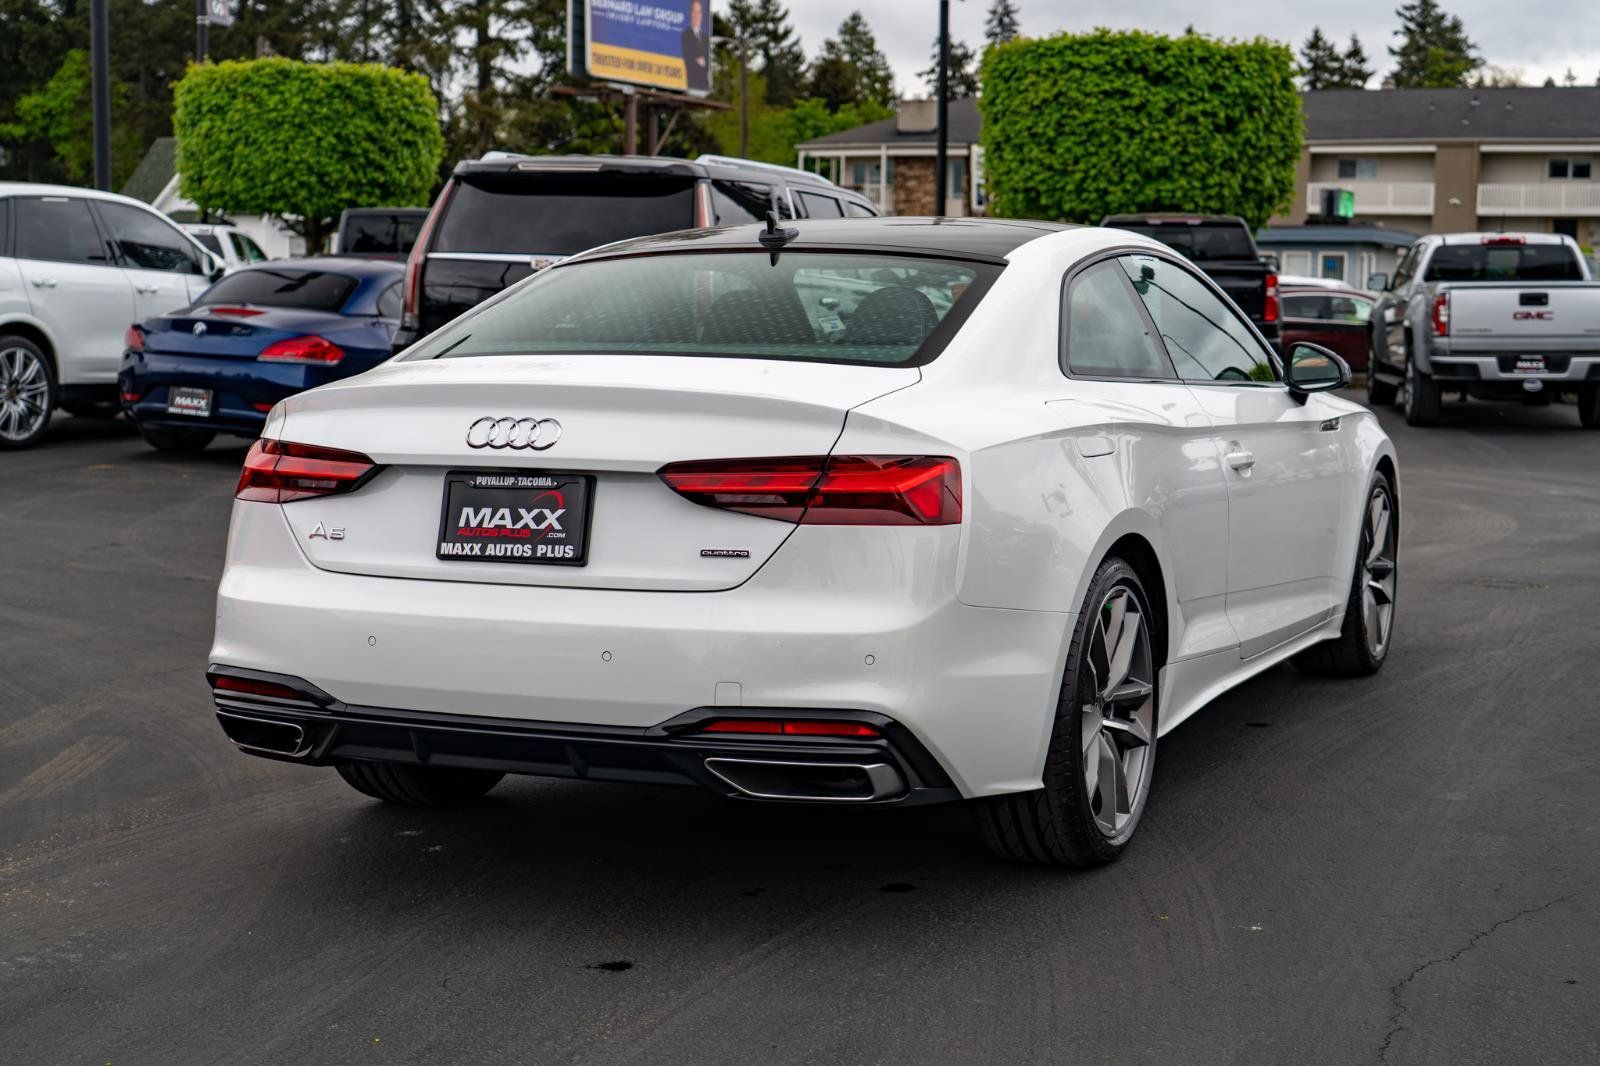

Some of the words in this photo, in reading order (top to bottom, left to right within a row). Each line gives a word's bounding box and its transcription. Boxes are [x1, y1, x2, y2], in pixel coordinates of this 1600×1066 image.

[634, 3, 654, 16] LAW
[654, 8, 684, 24] GROUP
[1513, 311, 1553, 321] GMC
[175, 396, 207, 408] MAXX
[458, 507, 567, 530] MAXX
[309, 520, 345, 540] A5
[457, 527, 498, 537] AUTOS
[499, 528, 531, 538] PLUS
[440, 542, 482, 556] MAXX
[486, 543, 532, 557] AUTOS
[537, 545, 574, 558] PLUS
